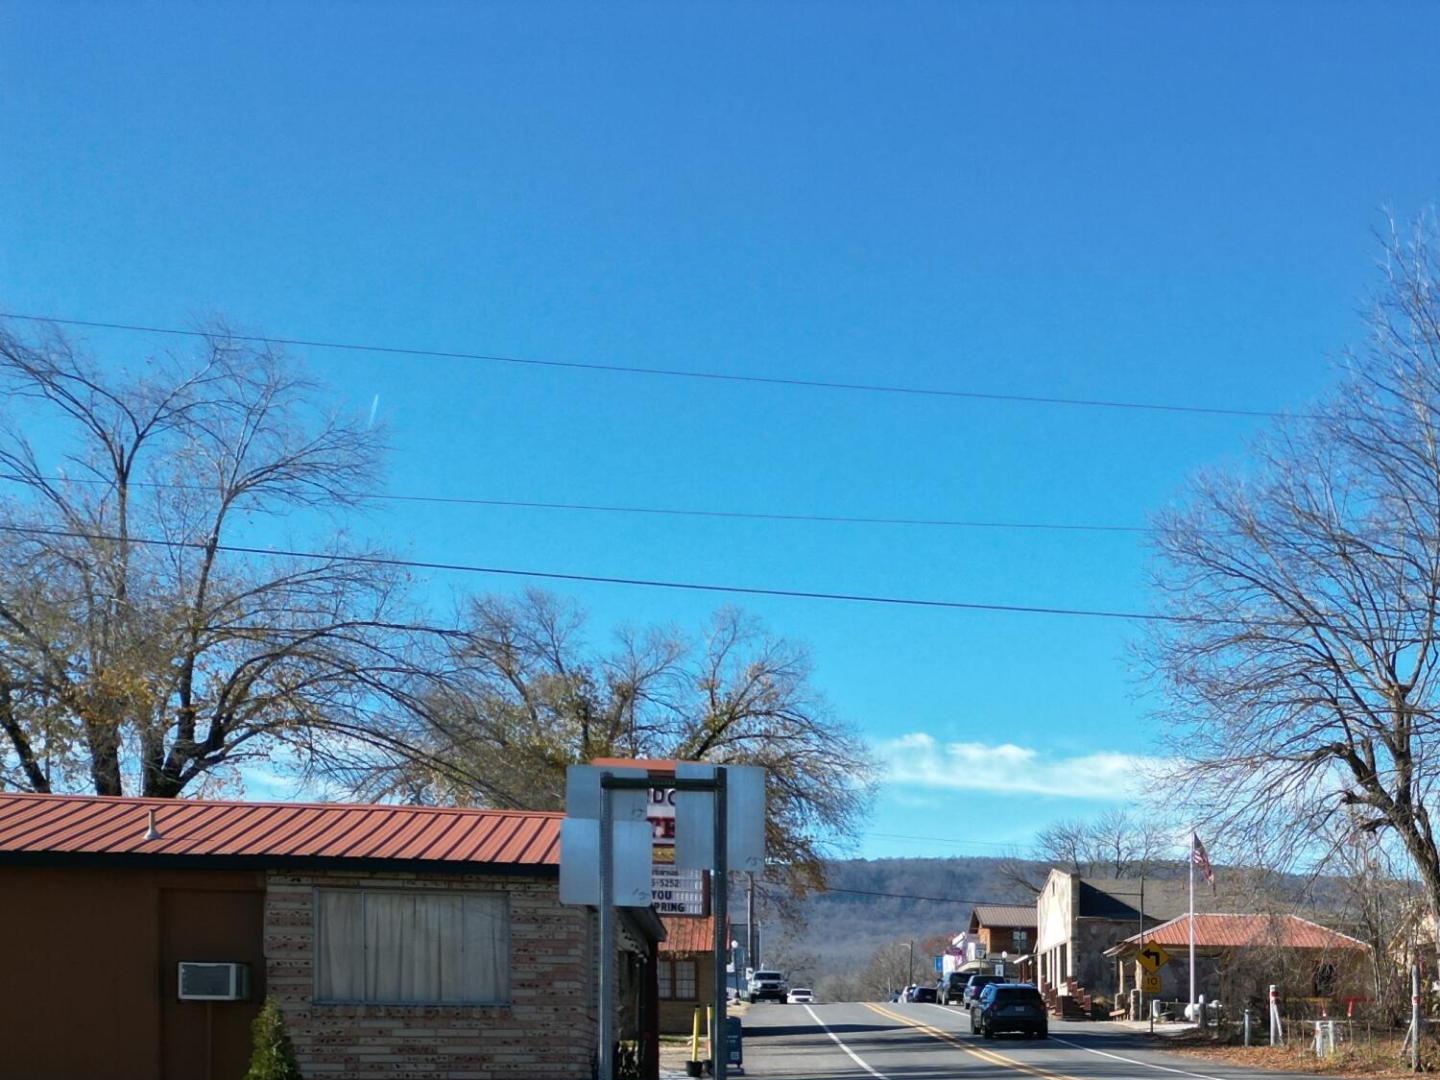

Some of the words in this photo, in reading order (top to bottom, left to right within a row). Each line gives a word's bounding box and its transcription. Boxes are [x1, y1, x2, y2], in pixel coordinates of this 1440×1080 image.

[651, 890, 672, 900] YOU
[654, 902, 685, 912] PRING
[1146, 977, 1158, 985] 10
